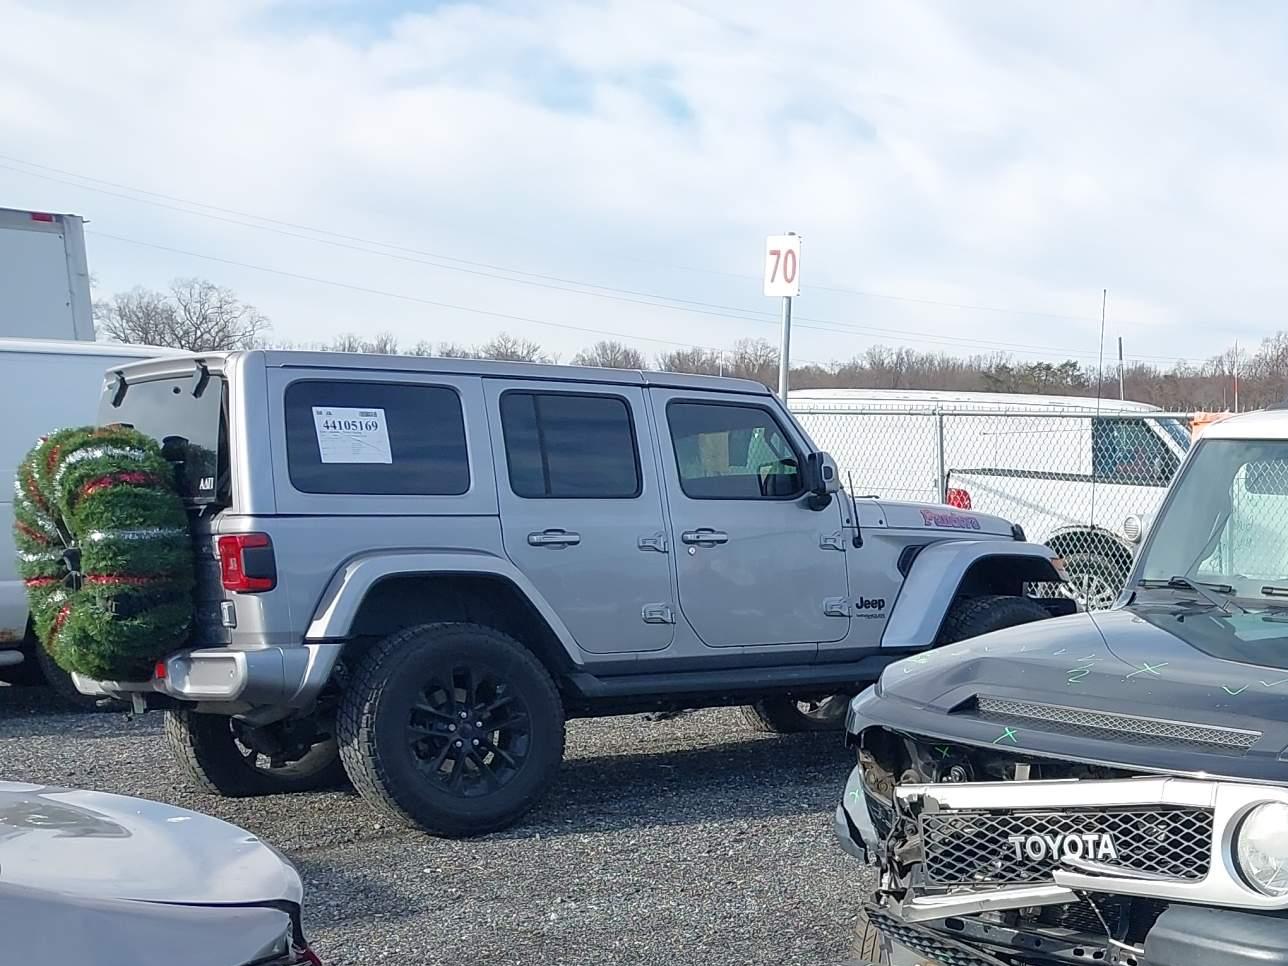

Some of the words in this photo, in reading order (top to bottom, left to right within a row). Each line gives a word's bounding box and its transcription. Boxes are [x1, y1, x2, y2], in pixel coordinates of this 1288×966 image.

[769, 249, 797, 284] 70
[322, 419, 379, 431] 44105169
[855, 596, 886, 611] Jeep
[1008, 833, 1119, 861] TOYOTA
